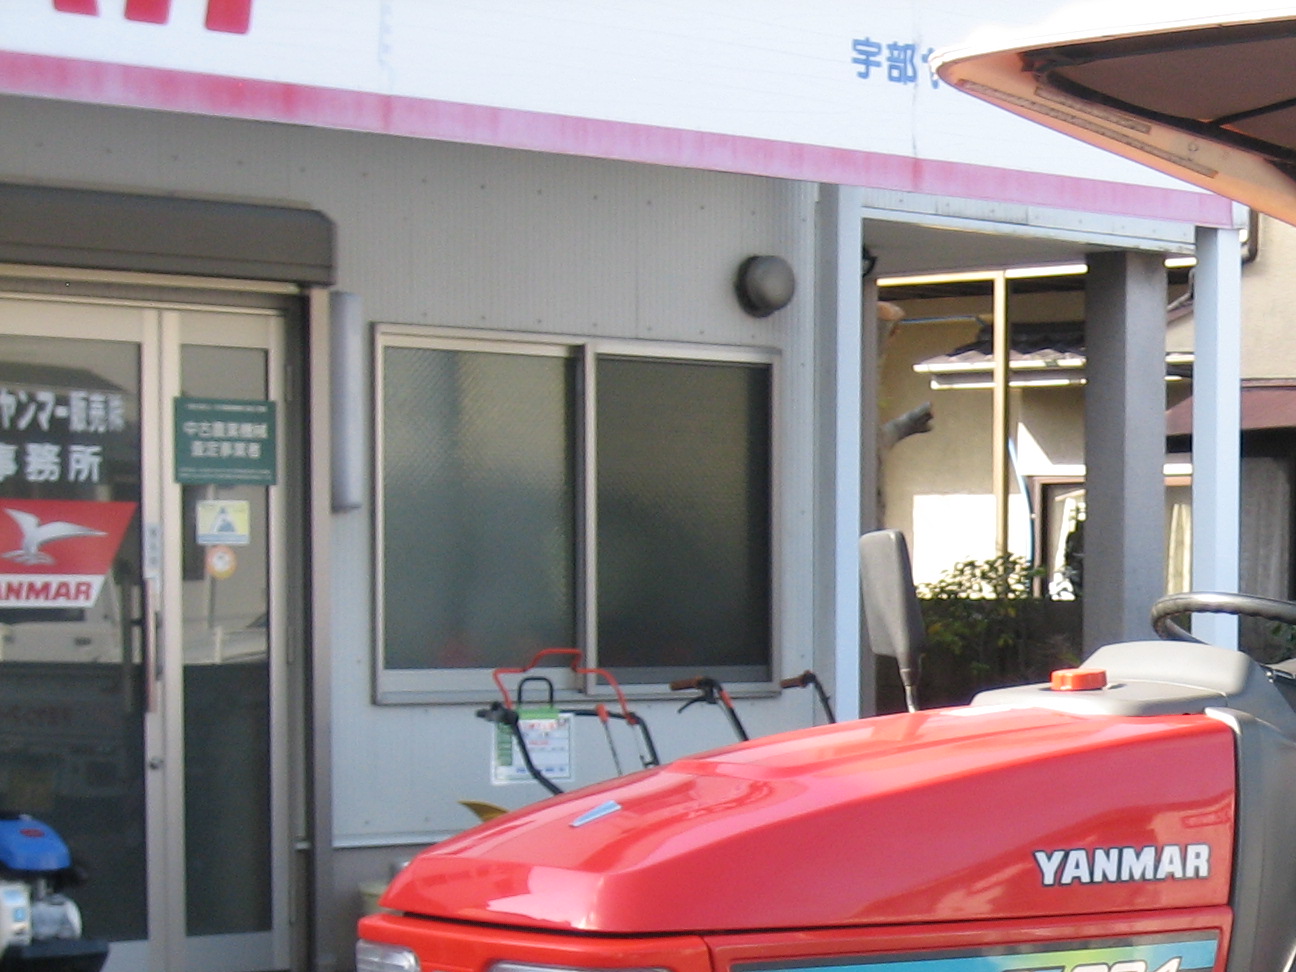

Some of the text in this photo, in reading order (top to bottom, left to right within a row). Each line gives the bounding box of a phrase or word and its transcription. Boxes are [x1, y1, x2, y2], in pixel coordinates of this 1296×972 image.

[851, 36, 940, 90] 宇部
[0, 581, 92, 601] NMAR
[1034, 844, 1211, 886] YANMAR
